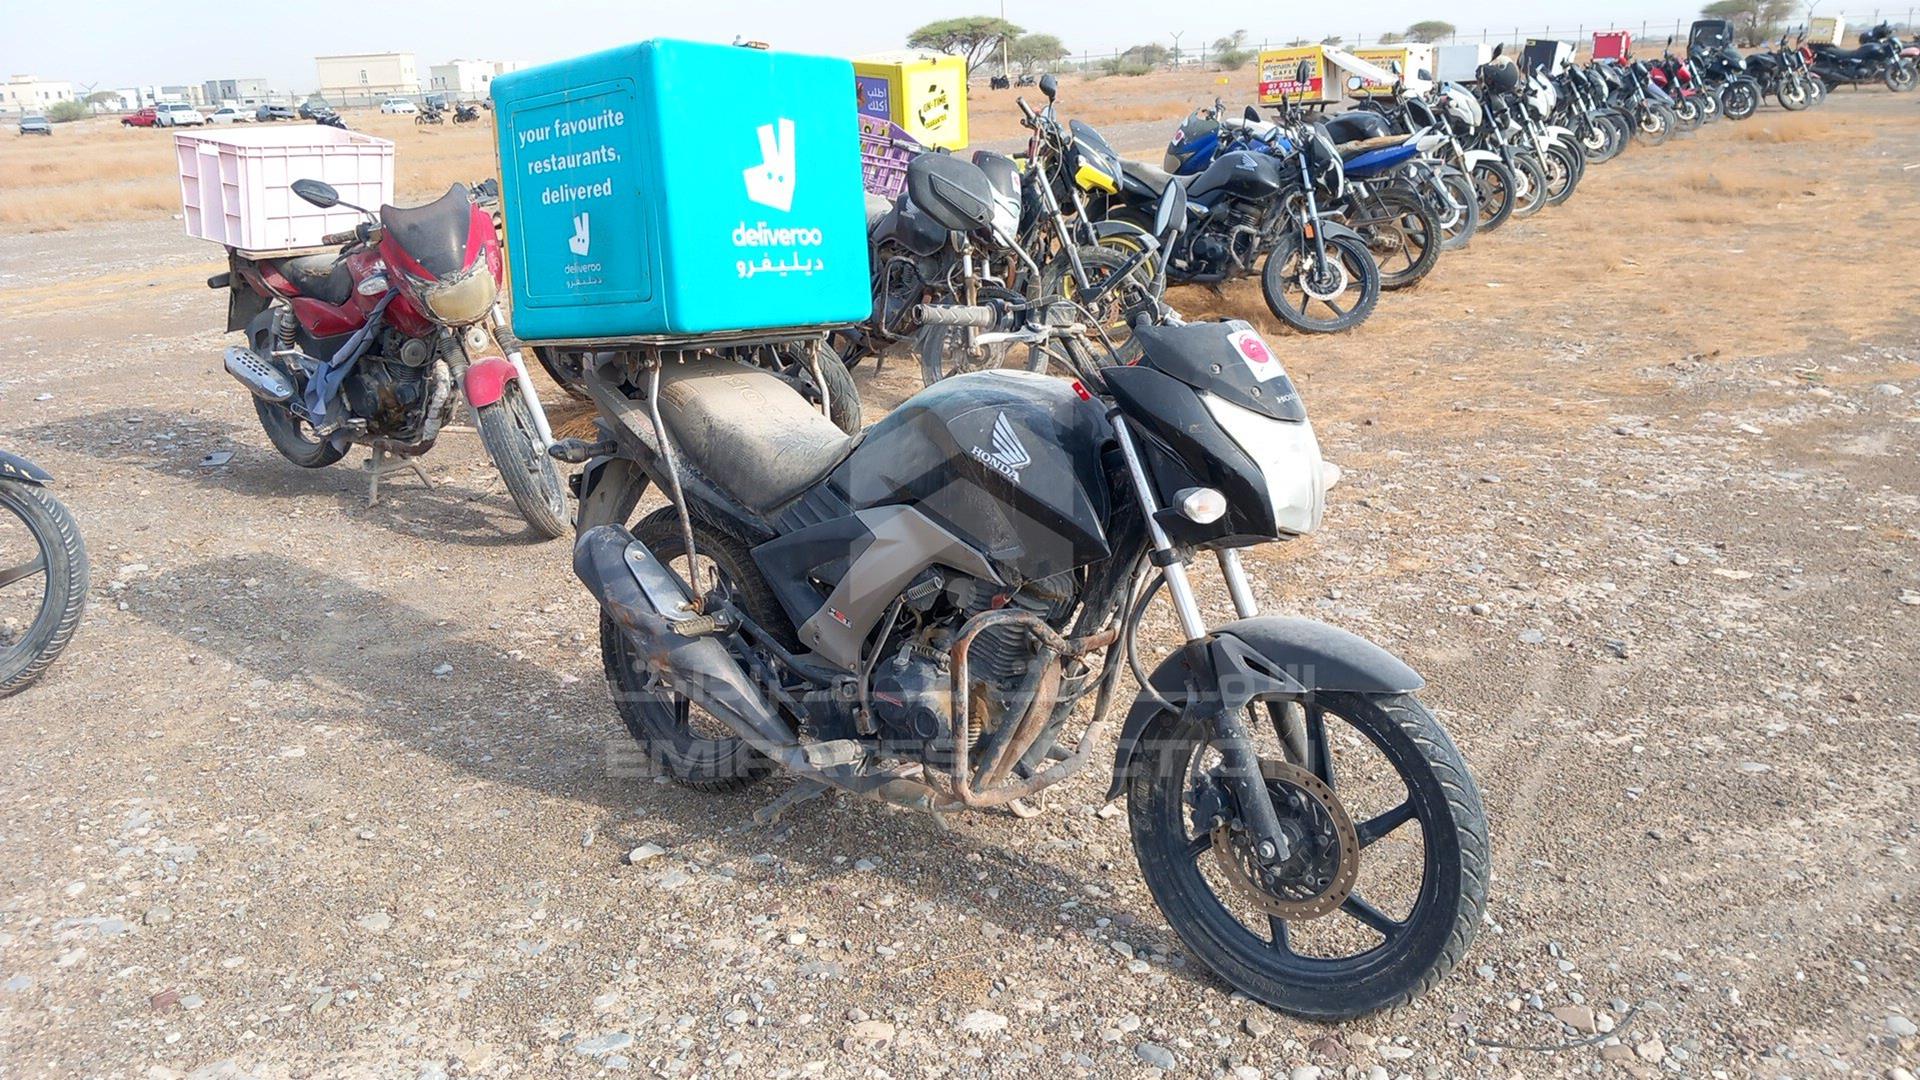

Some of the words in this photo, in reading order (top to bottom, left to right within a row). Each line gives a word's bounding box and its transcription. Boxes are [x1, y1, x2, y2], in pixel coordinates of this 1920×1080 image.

[867, 87, 887, 99] اطلب
[518, 125, 551, 149] your
[554, 109, 625, 138] favourite
[527, 143, 621, 176] restaurants,
[541, 178, 612, 206] delivered
[732, 221, 823, 247] deliveroo
[564, 261, 602, 275] deliveroo
[736, 251, 824, 279] ديليفرو
[971, 445, 1021, 484] HONDA
